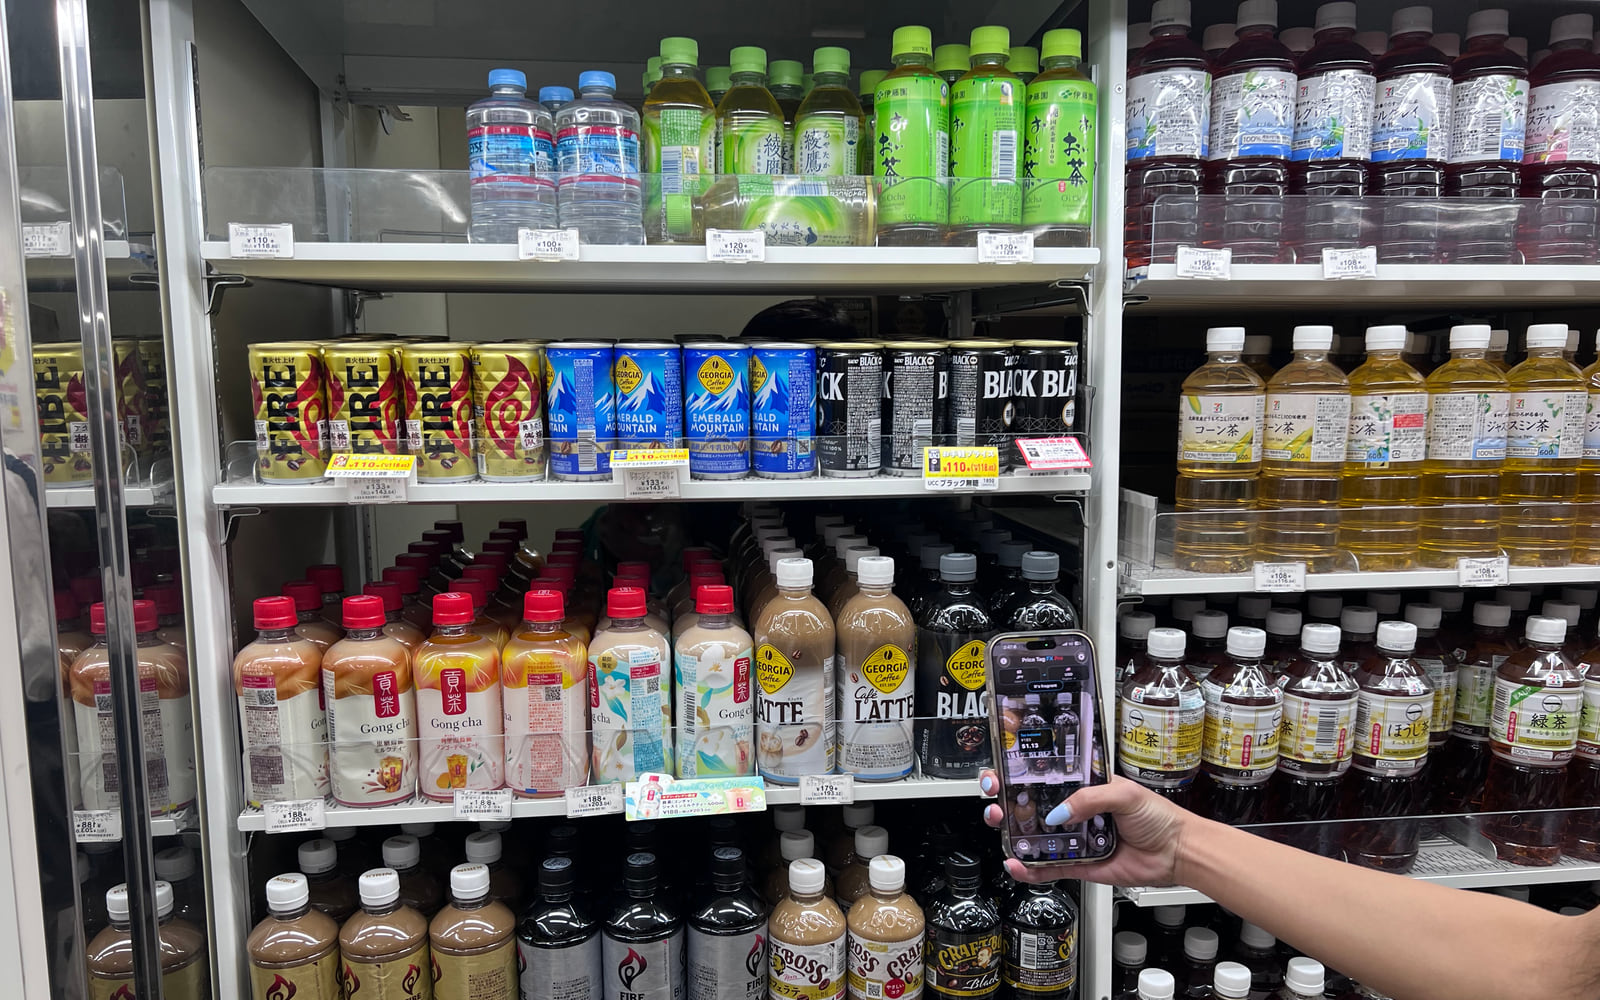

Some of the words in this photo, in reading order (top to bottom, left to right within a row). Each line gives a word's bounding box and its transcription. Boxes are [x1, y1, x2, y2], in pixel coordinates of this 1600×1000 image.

[860, 356, 879, 366] BLACK
[905, 356, 926, 366] BLACK
[952, 356, 970, 365] BLACK
[700, 371, 732, 380] GEORGIA
[707, 379, 726, 387] Coffee
[263, 364, 302, 455] FIRE
[346, 365, 384, 455] FIRE
[419, 365, 456, 454] FIRE
[692, 413, 742, 423] EMERALD
[691, 423, 744, 433] MOUNTAIN
[1195, 423, 1239, 438] コーン茶
[1508, 419, 1550, 433] スミン茶
[943, 462, 966, 472] ¥110
[941, 479, 980, 487] ブラック無糖
[866, 662, 909, 674] GEORGIA
[760, 673, 781, 683] Coffee
[874, 673, 900, 683] Coffee
[376, 672, 395, 716] 貢茶
[444, 670, 462, 713] 貢茶
[854, 686, 878, 704] Café
[719, 709, 745, 719] Gong
[854, 694, 914, 724] LATTE
[360, 722, 394, 734] Gong
[431, 718, 460, 731] Gong
[462, 717, 482, 728] cha
[1530, 713, 1567, 729] 緑茶
[1388, 720, 1430, 738] ほうじ茶
[283, 811, 302, 819] ¥188
[938, 937, 989, 970] CRAFT
[780, 948, 828, 985] BOSS
[746, 974, 765, 992] FIRE
[962, 970, 1000, 989] Black
